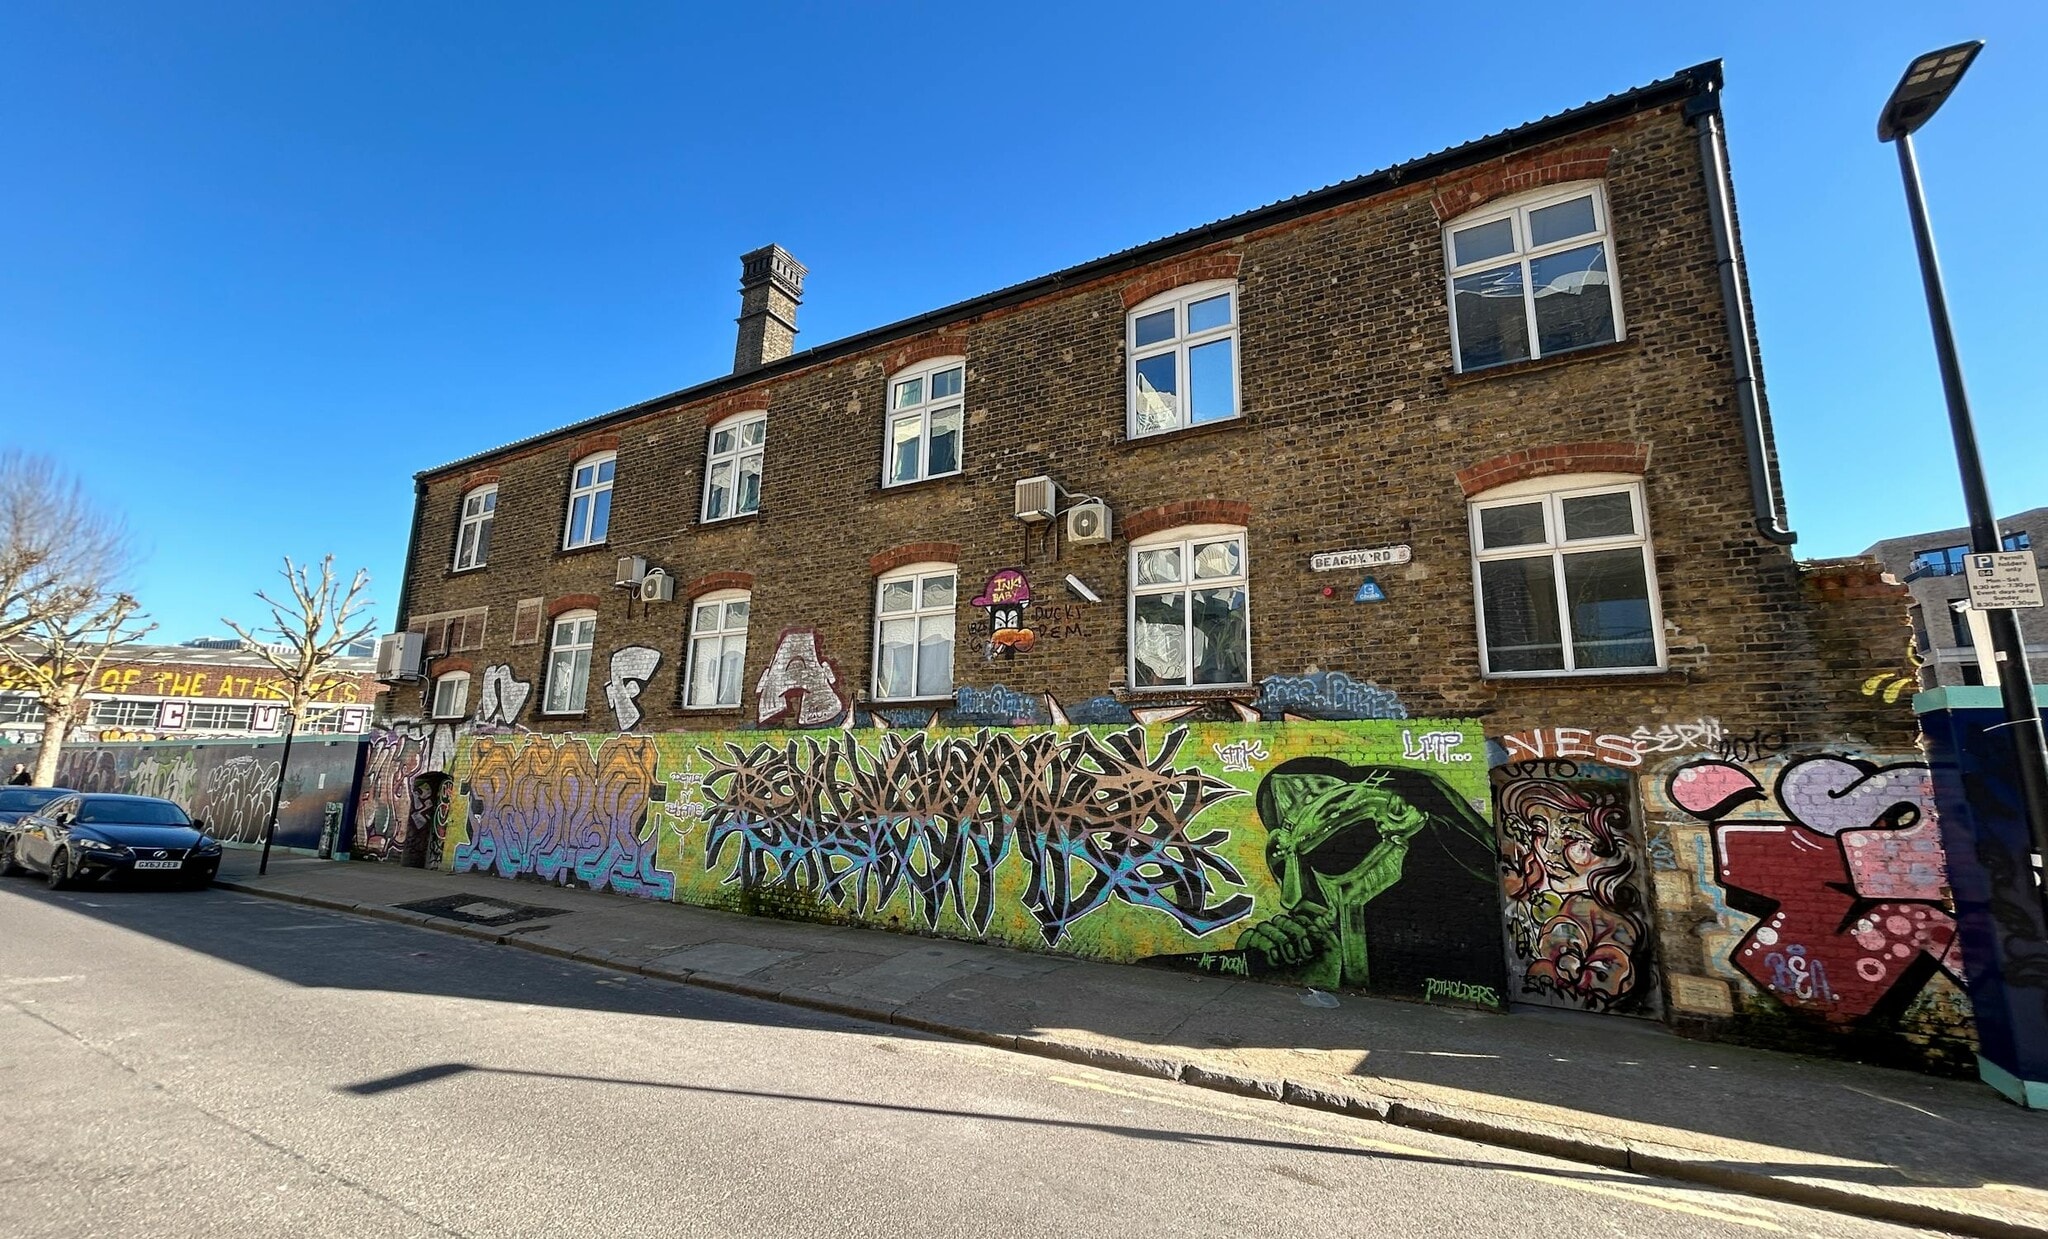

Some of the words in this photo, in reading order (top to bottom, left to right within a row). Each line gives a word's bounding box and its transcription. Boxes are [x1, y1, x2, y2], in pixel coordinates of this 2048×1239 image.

[100, 668, 141, 693] OF
[153, 671, 207, 697] THE
[1425, 977, 1499, 1008] POTHOLDERS
